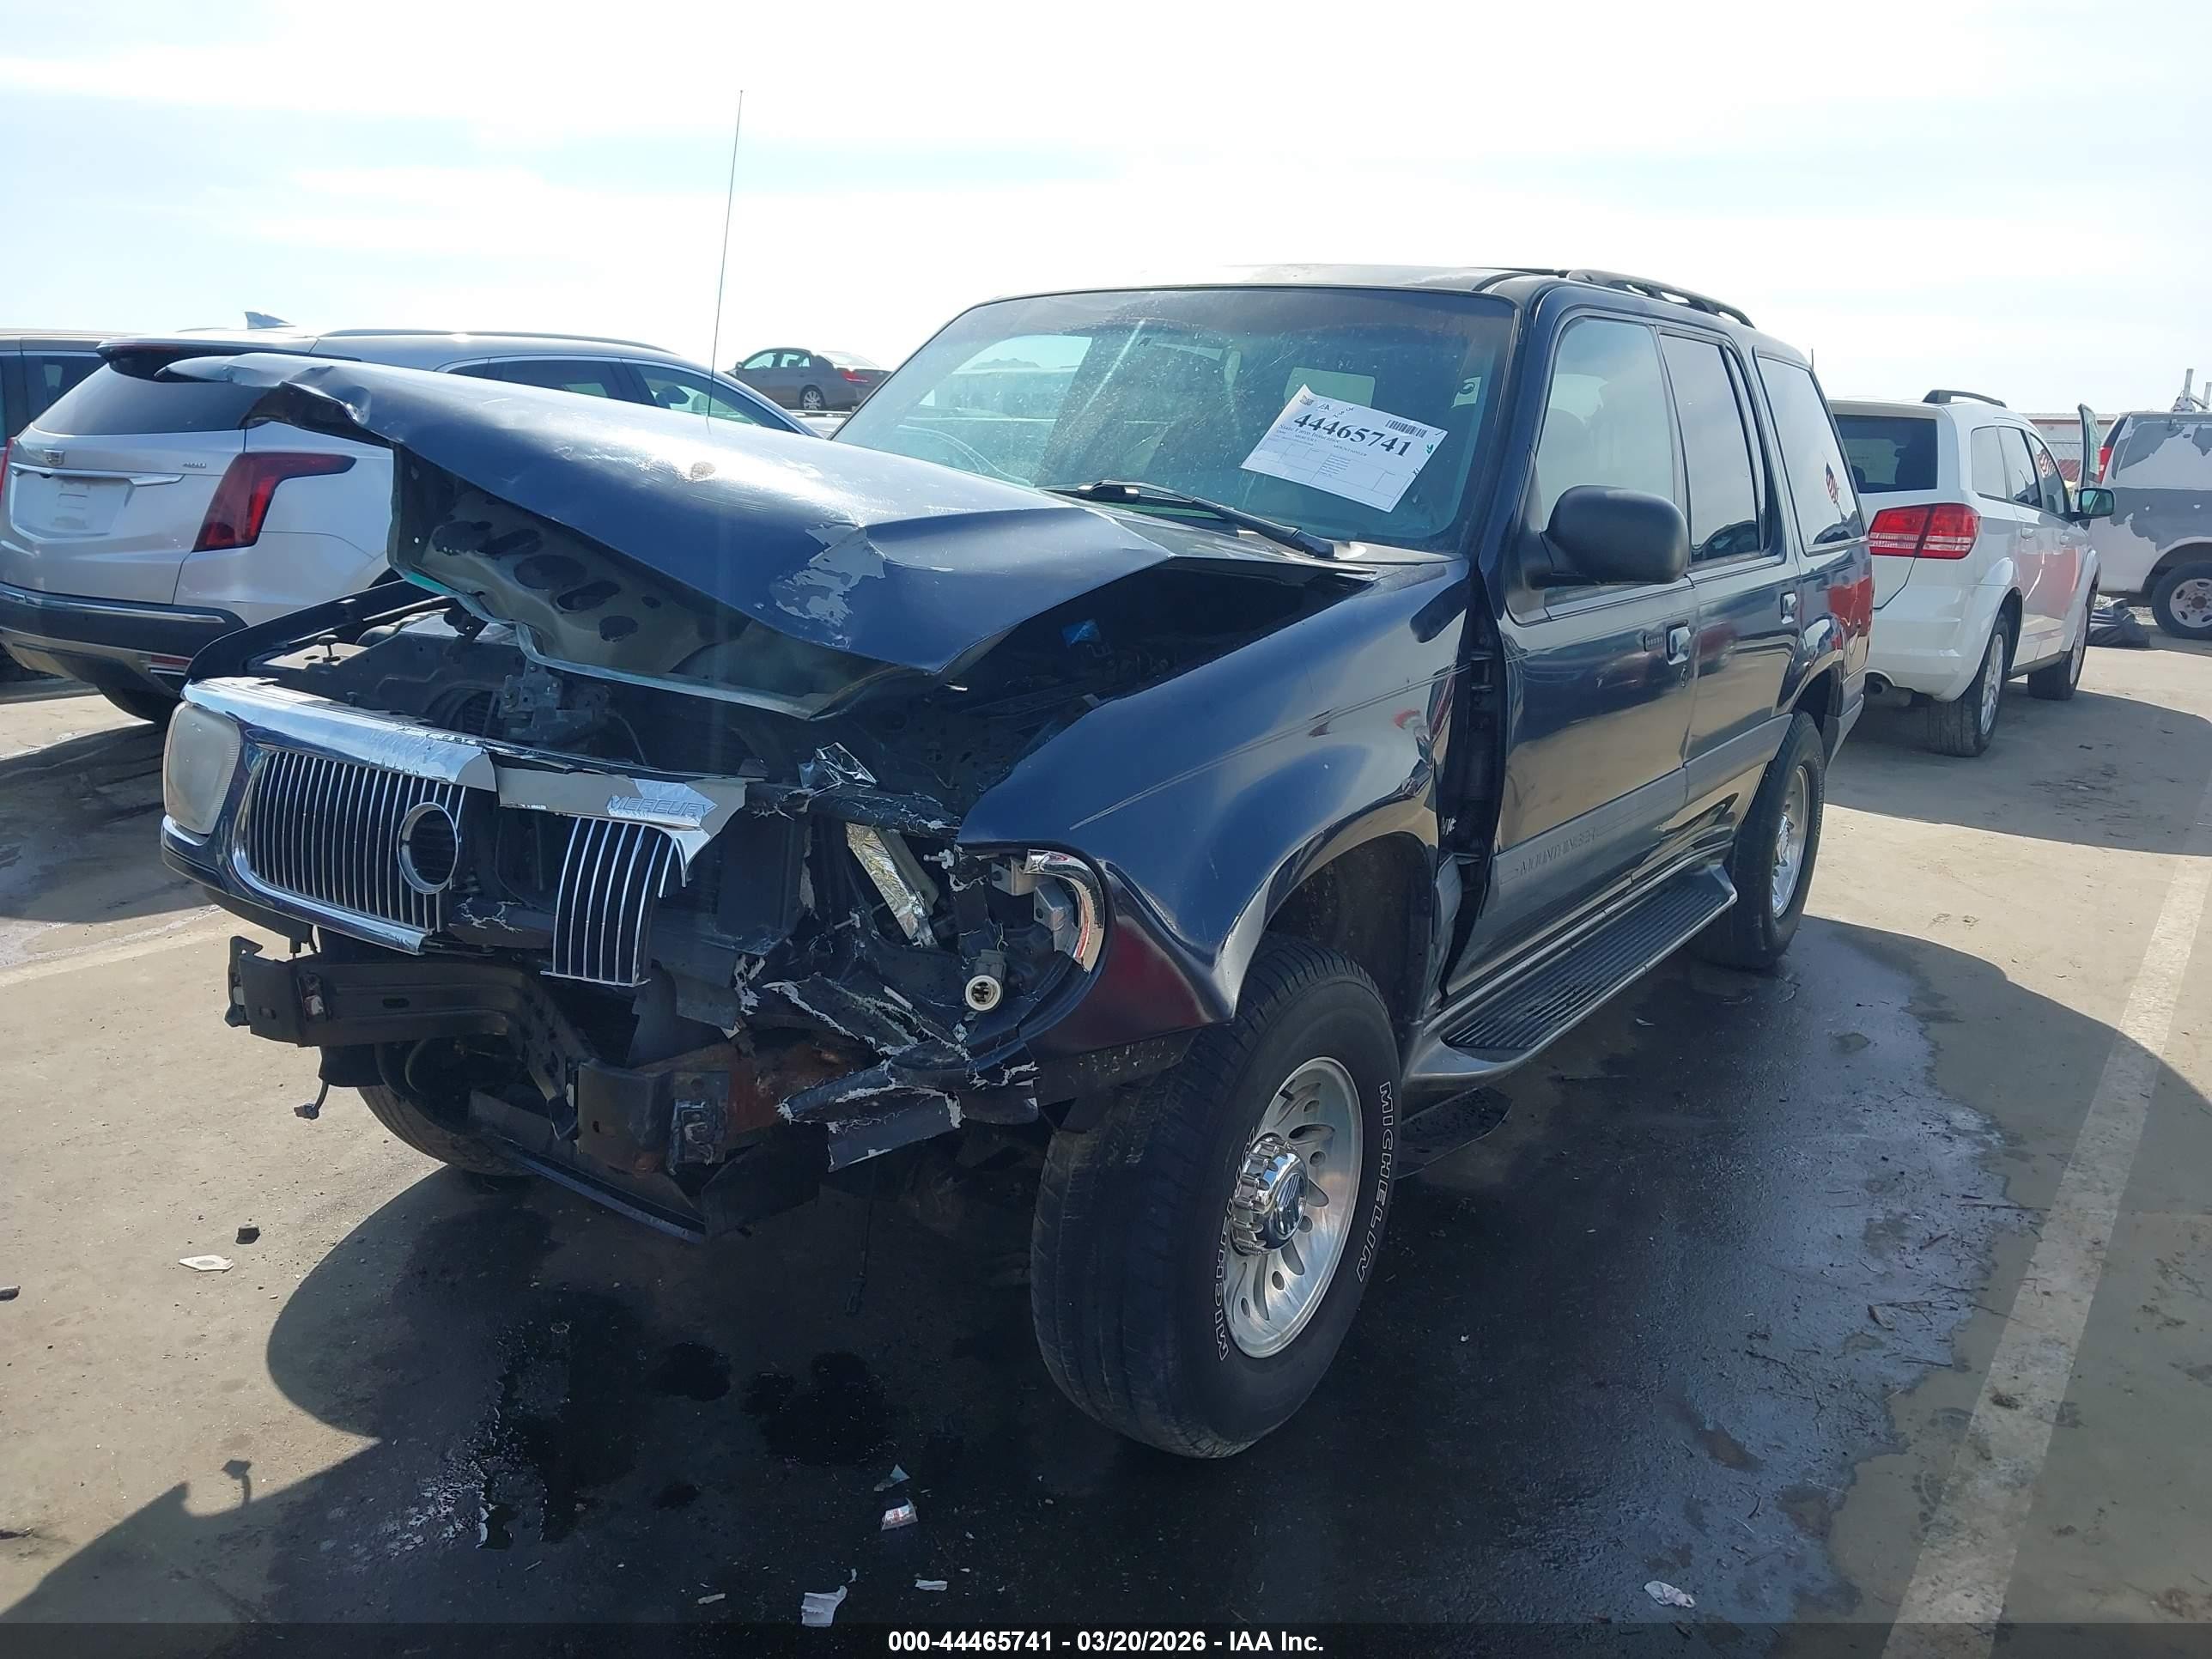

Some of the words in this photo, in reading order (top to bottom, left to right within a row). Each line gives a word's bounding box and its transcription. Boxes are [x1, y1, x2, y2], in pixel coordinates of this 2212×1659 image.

[1279, 423, 1293, 432] State
[1294, 426, 1311, 435] Farm
[1311, 431, 1339, 443] Insurance
[1293, 413, 1412, 457] 44465741
[1355, 1080, 1395, 1284] MICHELIN
